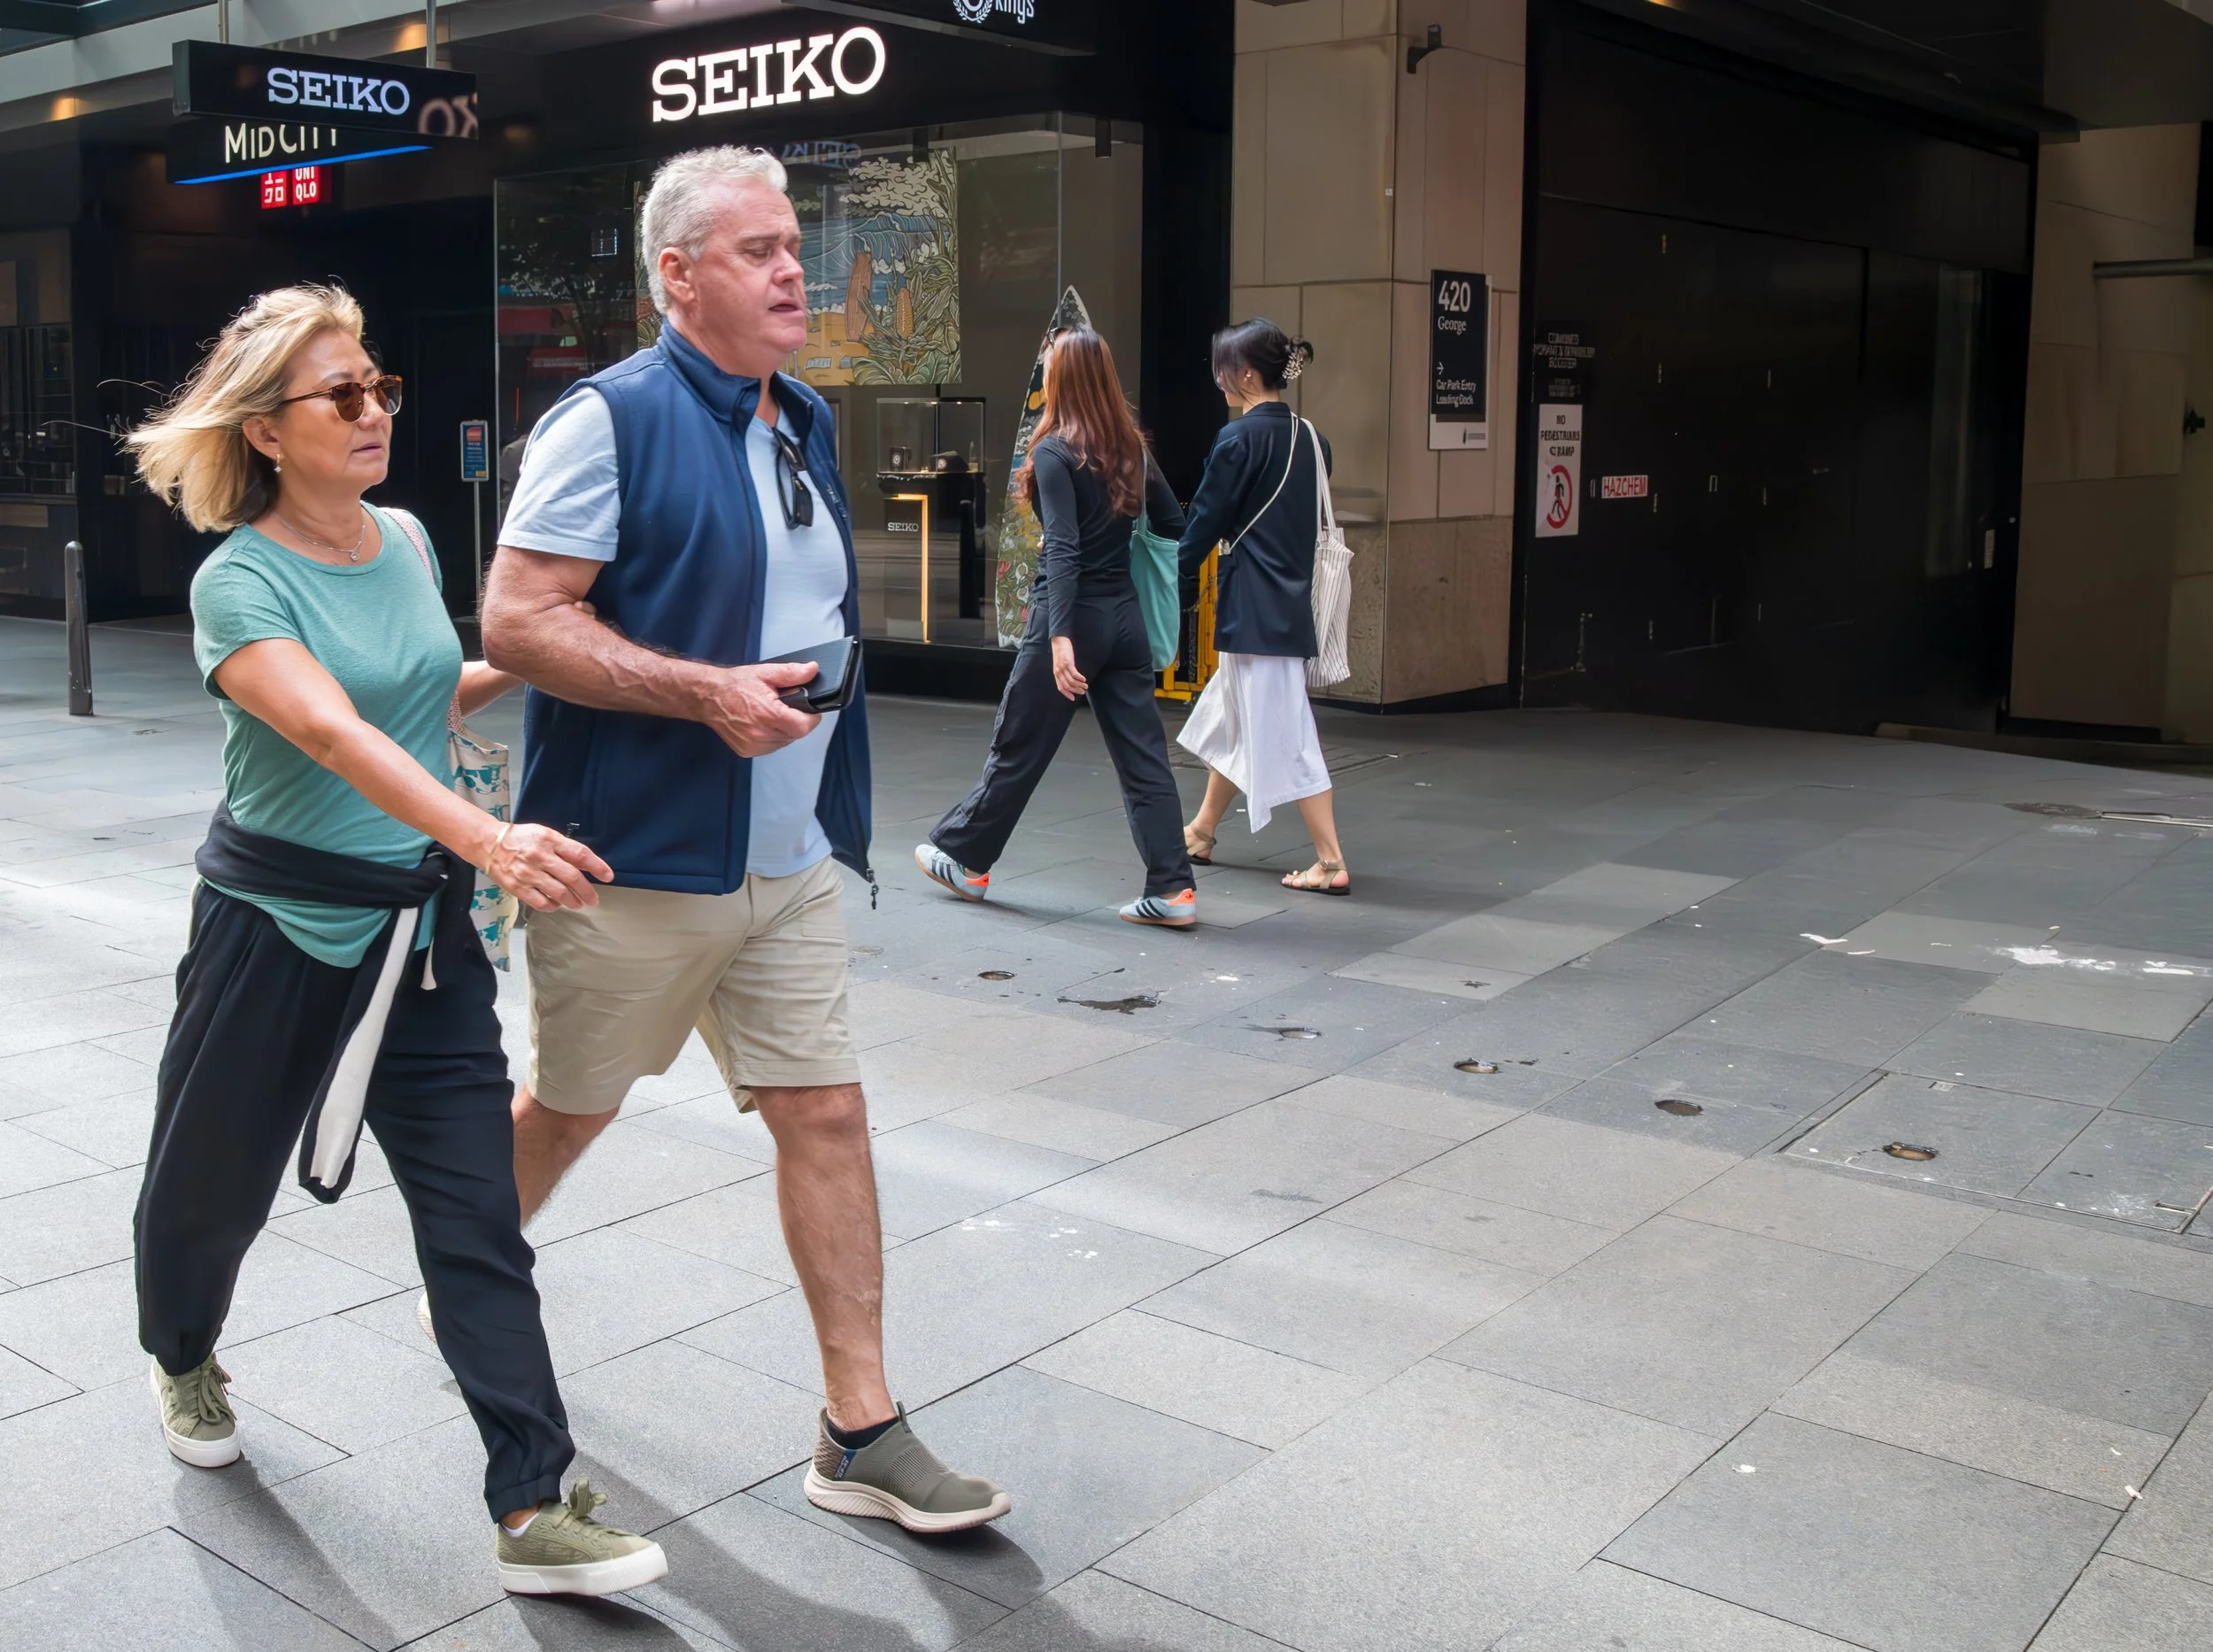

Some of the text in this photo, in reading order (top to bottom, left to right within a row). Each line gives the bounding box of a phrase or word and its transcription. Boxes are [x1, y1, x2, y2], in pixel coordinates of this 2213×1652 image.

[652, 26, 885, 122] SEIKO
[267, 67, 411, 116] SEIKO
[295, 181, 317, 202] QLO
[1438, 280, 1471, 313] 420
[1438, 315, 1467, 336] George
[1461, 379, 1477, 393] Entry
[1603, 477, 1646, 497] HAZCHEM
[888, 521, 919, 532] SEIKO
